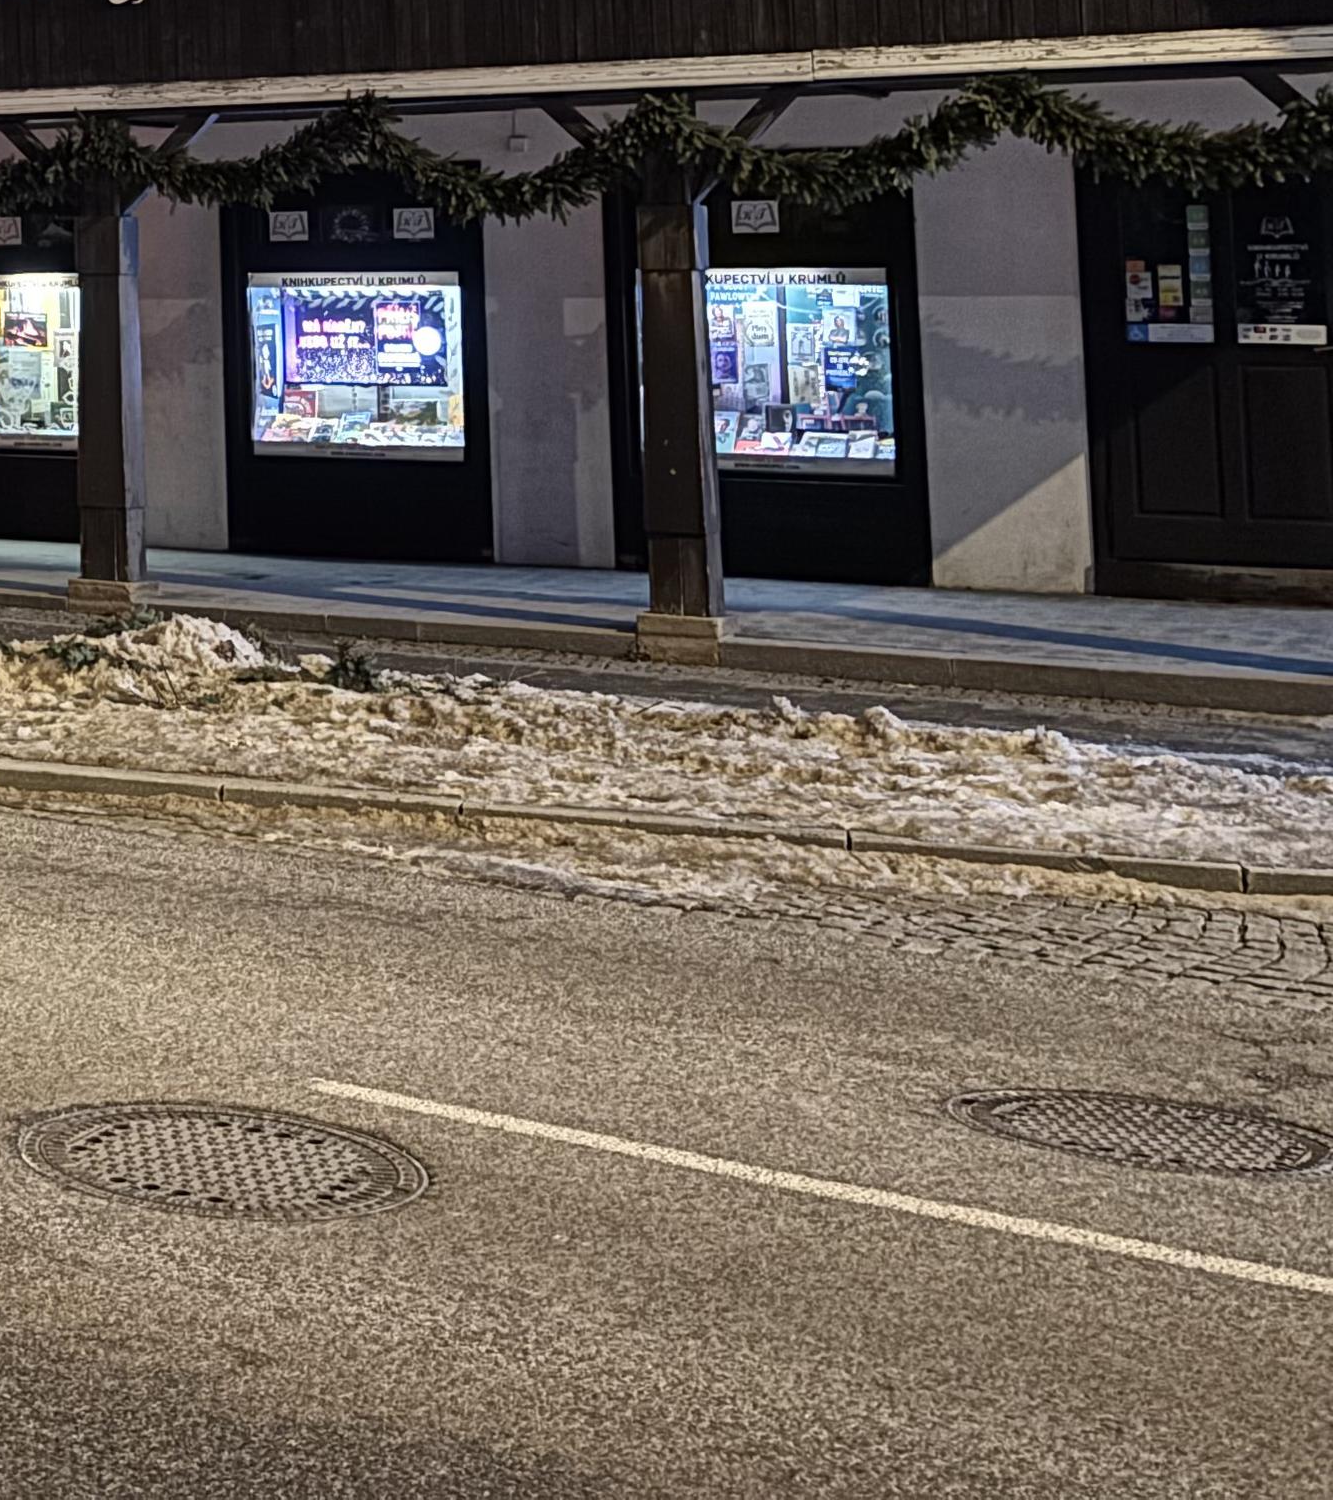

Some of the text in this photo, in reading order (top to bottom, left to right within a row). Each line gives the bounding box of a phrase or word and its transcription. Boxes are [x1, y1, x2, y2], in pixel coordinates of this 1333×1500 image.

[282, 273, 363, 287] KNIHKUPECTVÍ
[366, 276, 375, 287] U
[775, 274, 784, 285] U
[789, 271, 846, 285] KRUMLŮ
